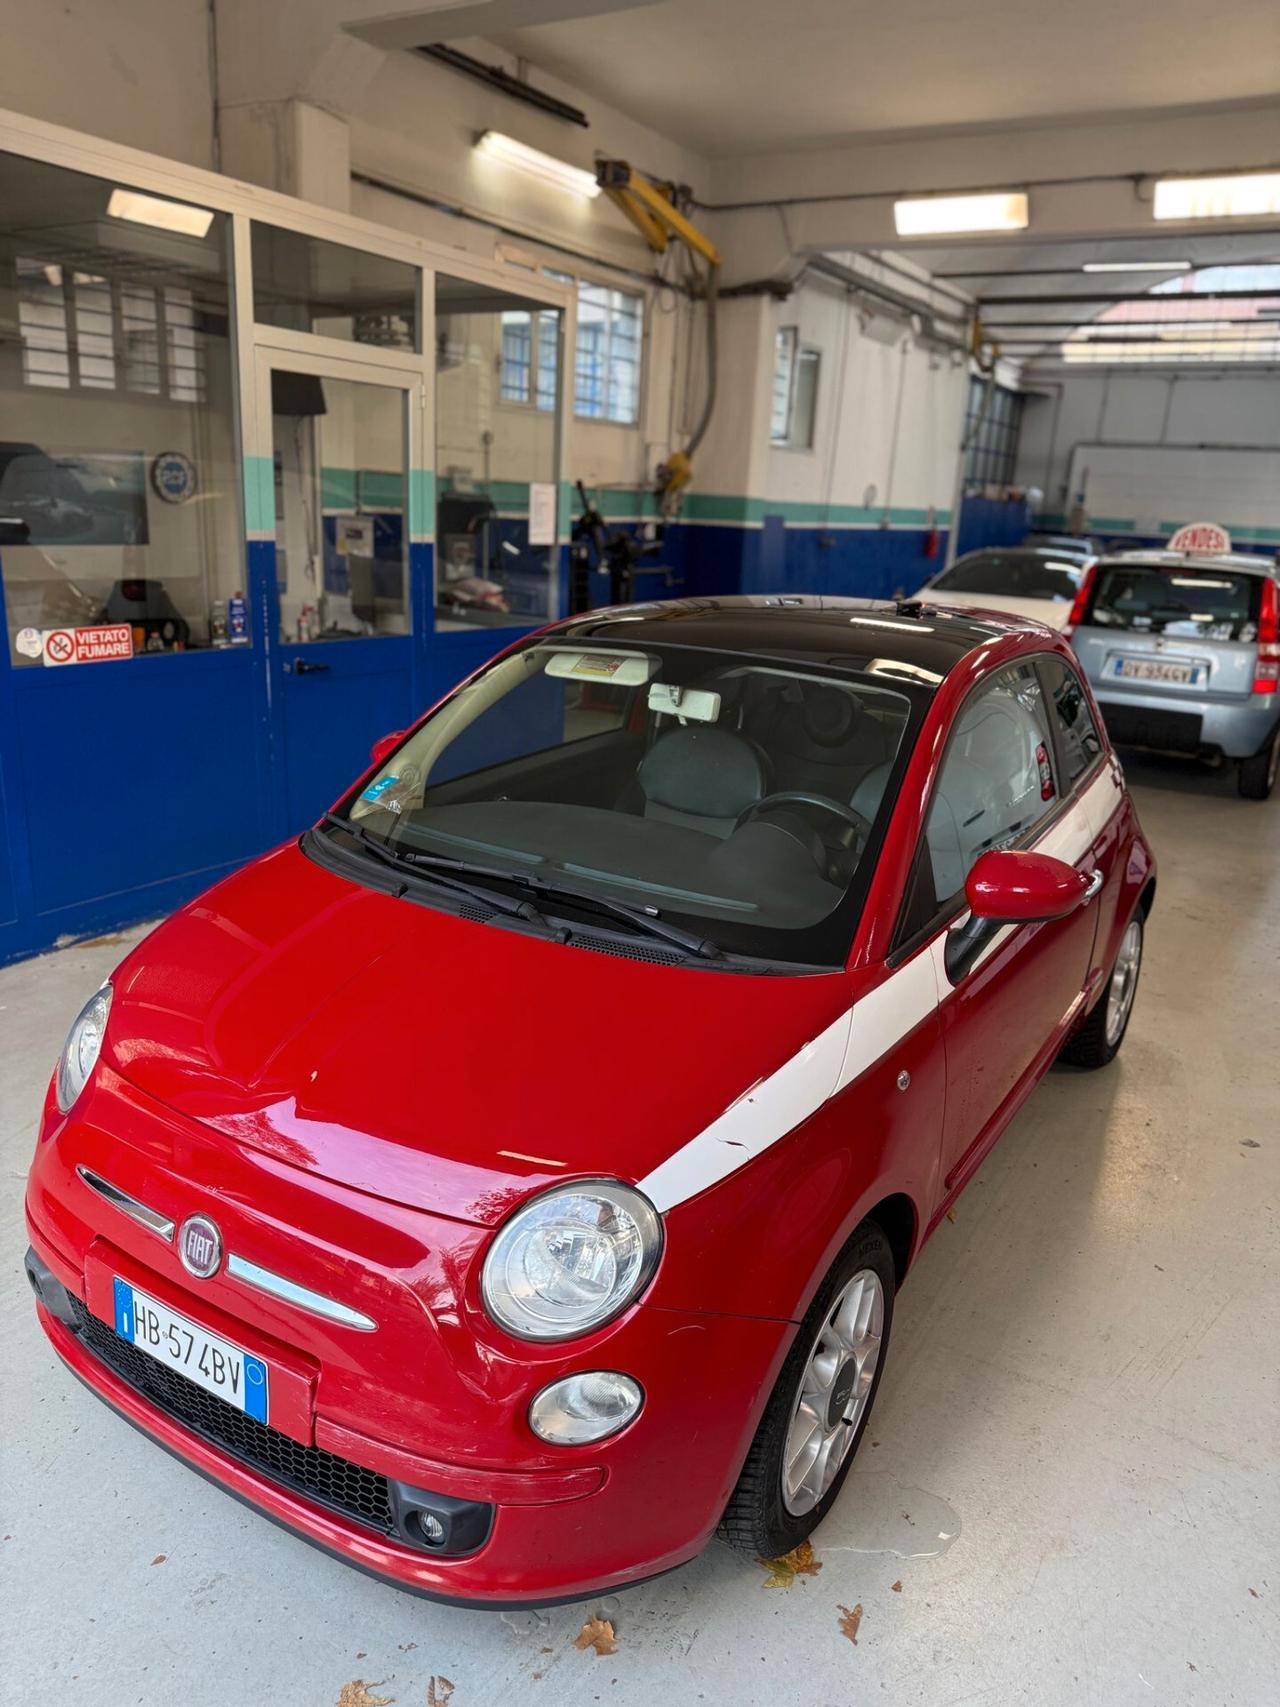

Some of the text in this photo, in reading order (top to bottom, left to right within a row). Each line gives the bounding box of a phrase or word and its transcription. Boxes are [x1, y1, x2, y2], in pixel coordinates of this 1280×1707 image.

[76, 628, 129, 645] VIETATO
[78, 642, 130, 659] FUMARE
[187, 1230, 214, 1265] FIAT
